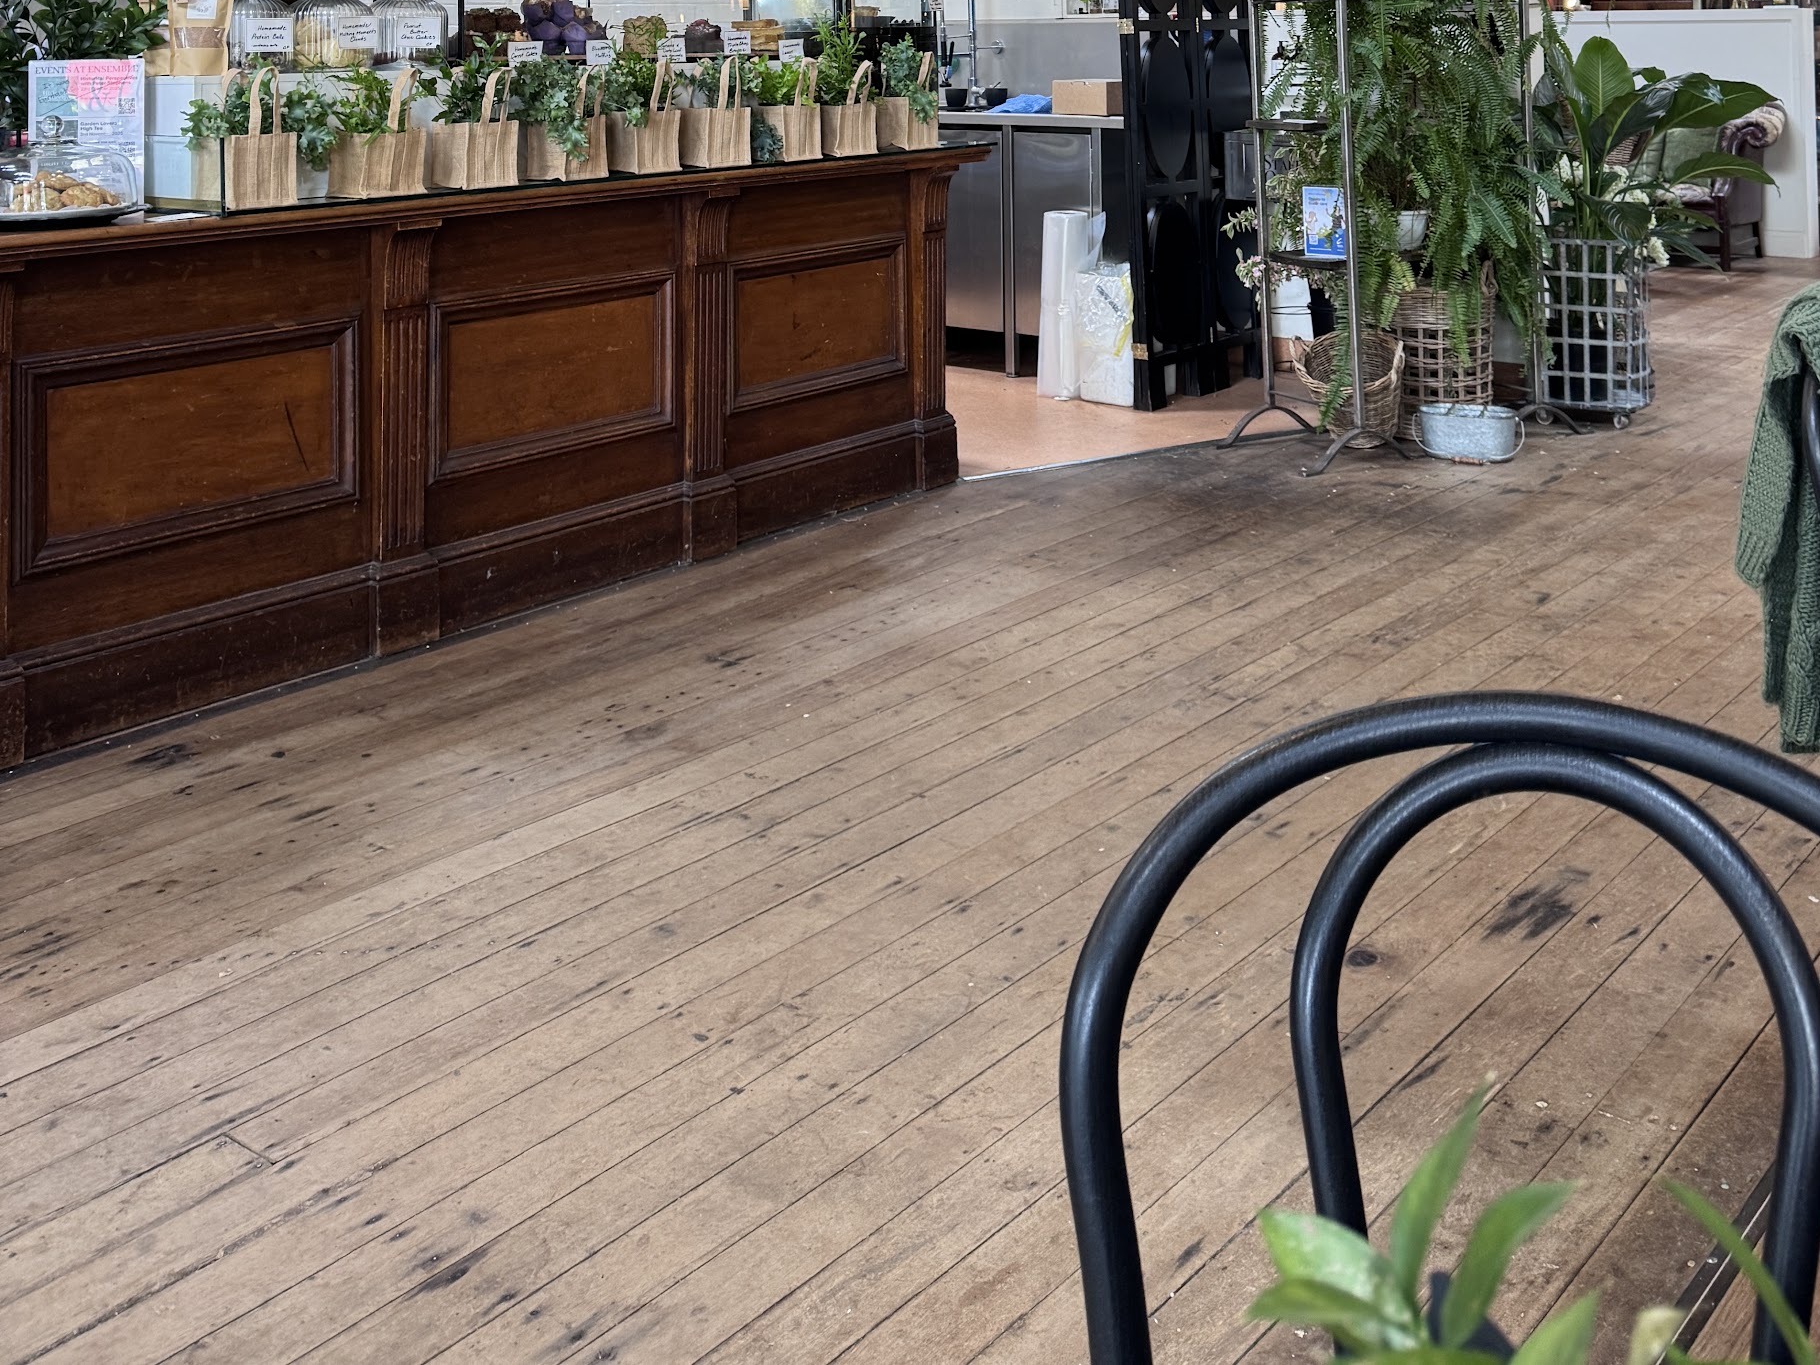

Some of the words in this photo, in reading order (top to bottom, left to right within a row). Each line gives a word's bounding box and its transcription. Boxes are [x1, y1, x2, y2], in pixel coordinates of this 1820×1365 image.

[35, 66, 72, 74] EVENTS
[73, 66, 87, 74] AT
[88, 64, 139, 73] ENSEMBLE
